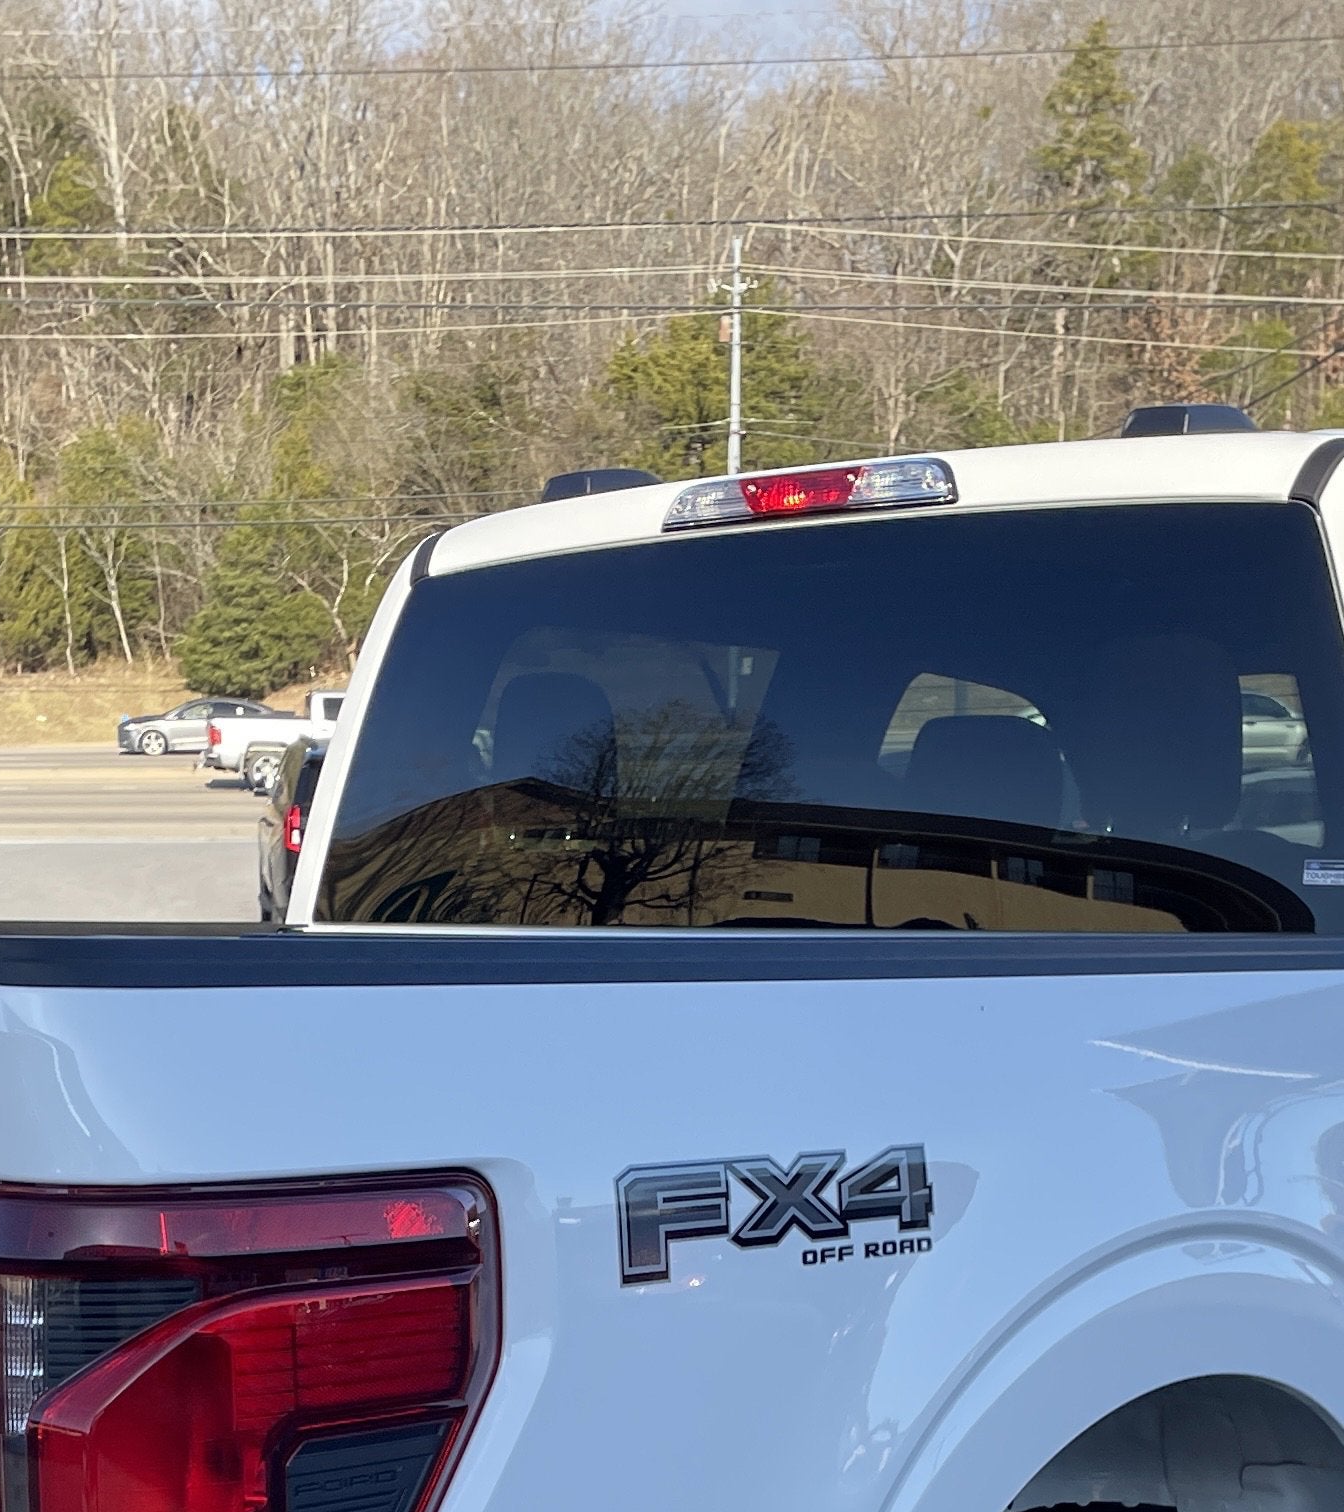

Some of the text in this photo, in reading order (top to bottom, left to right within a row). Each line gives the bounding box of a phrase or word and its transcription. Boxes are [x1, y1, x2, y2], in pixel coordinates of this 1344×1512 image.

[613, 1143, 933, 1288] FX4
[801, 1237, 933, 1266] OFF ROAD
[294, 1468, 399, 1497] FORD
